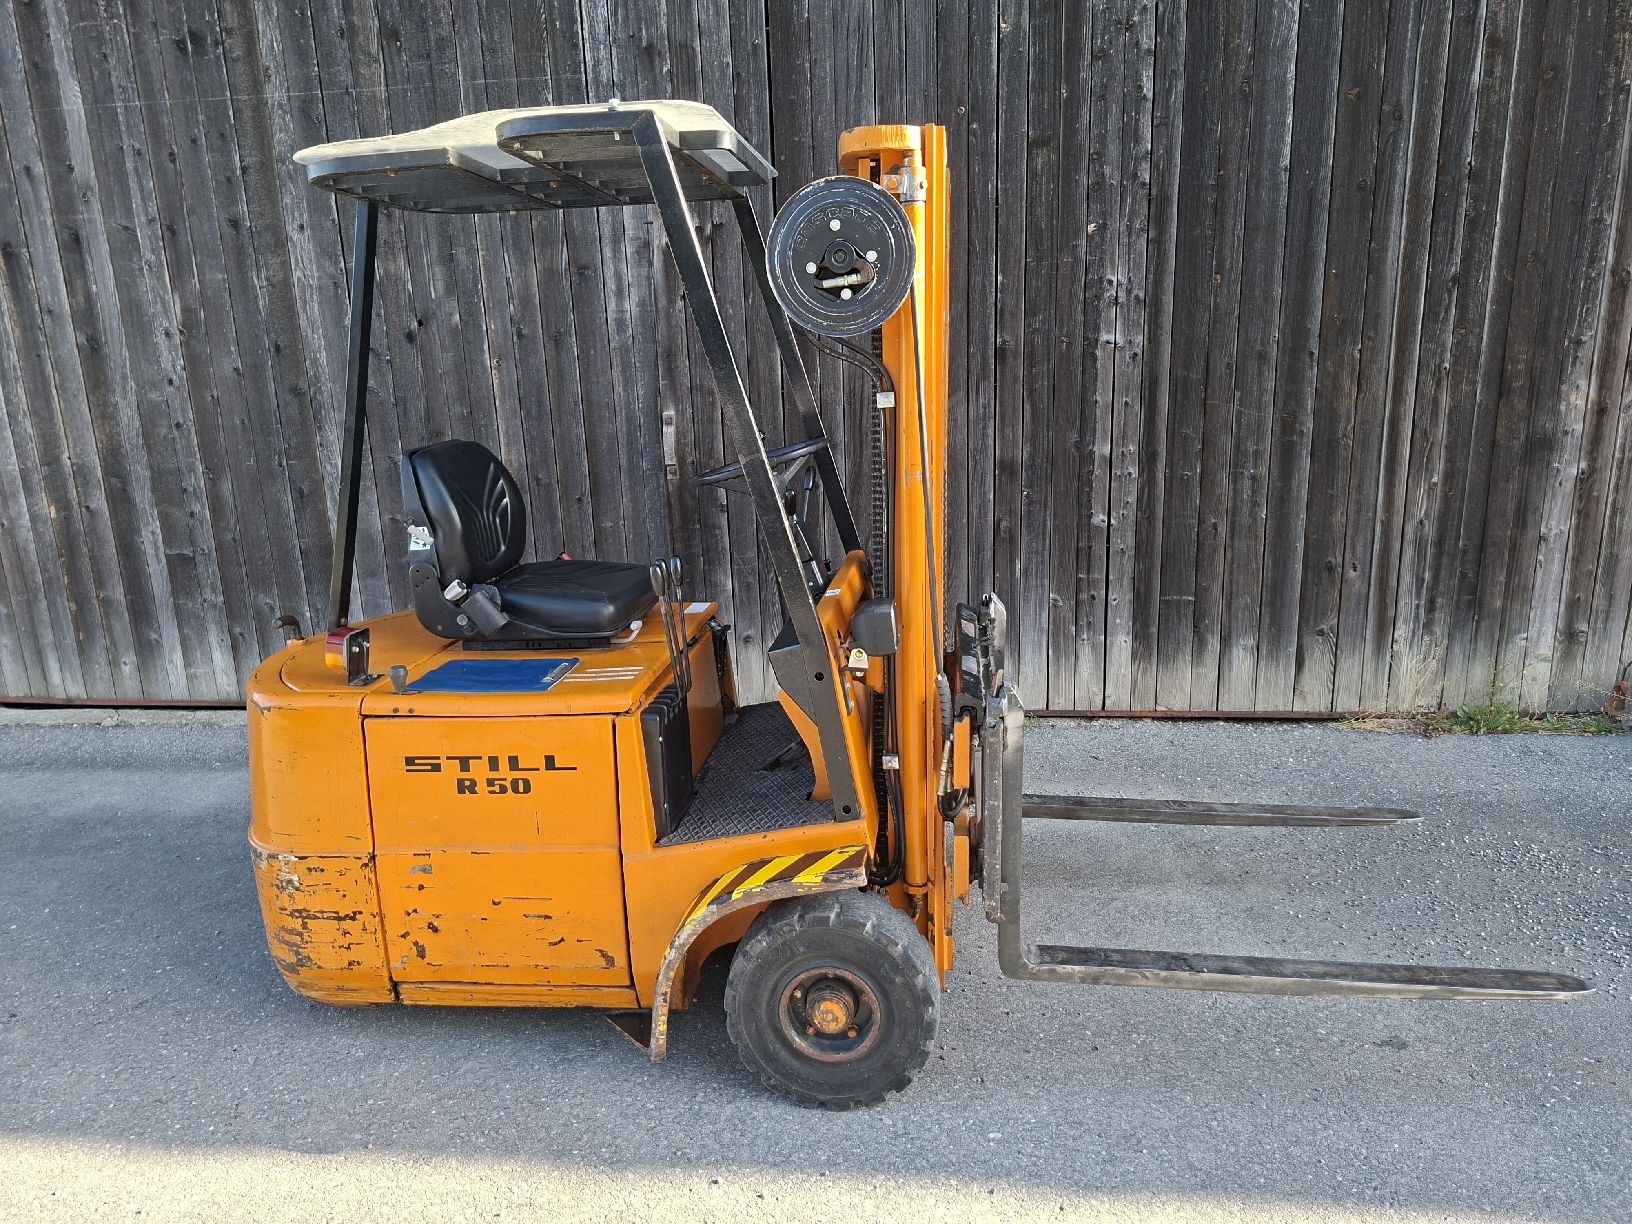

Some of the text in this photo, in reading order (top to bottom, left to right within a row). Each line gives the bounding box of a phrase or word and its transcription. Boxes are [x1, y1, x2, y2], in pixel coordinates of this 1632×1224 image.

[404, 754, 577, 773] STILL
[456, 777, 532, 795] R 50
